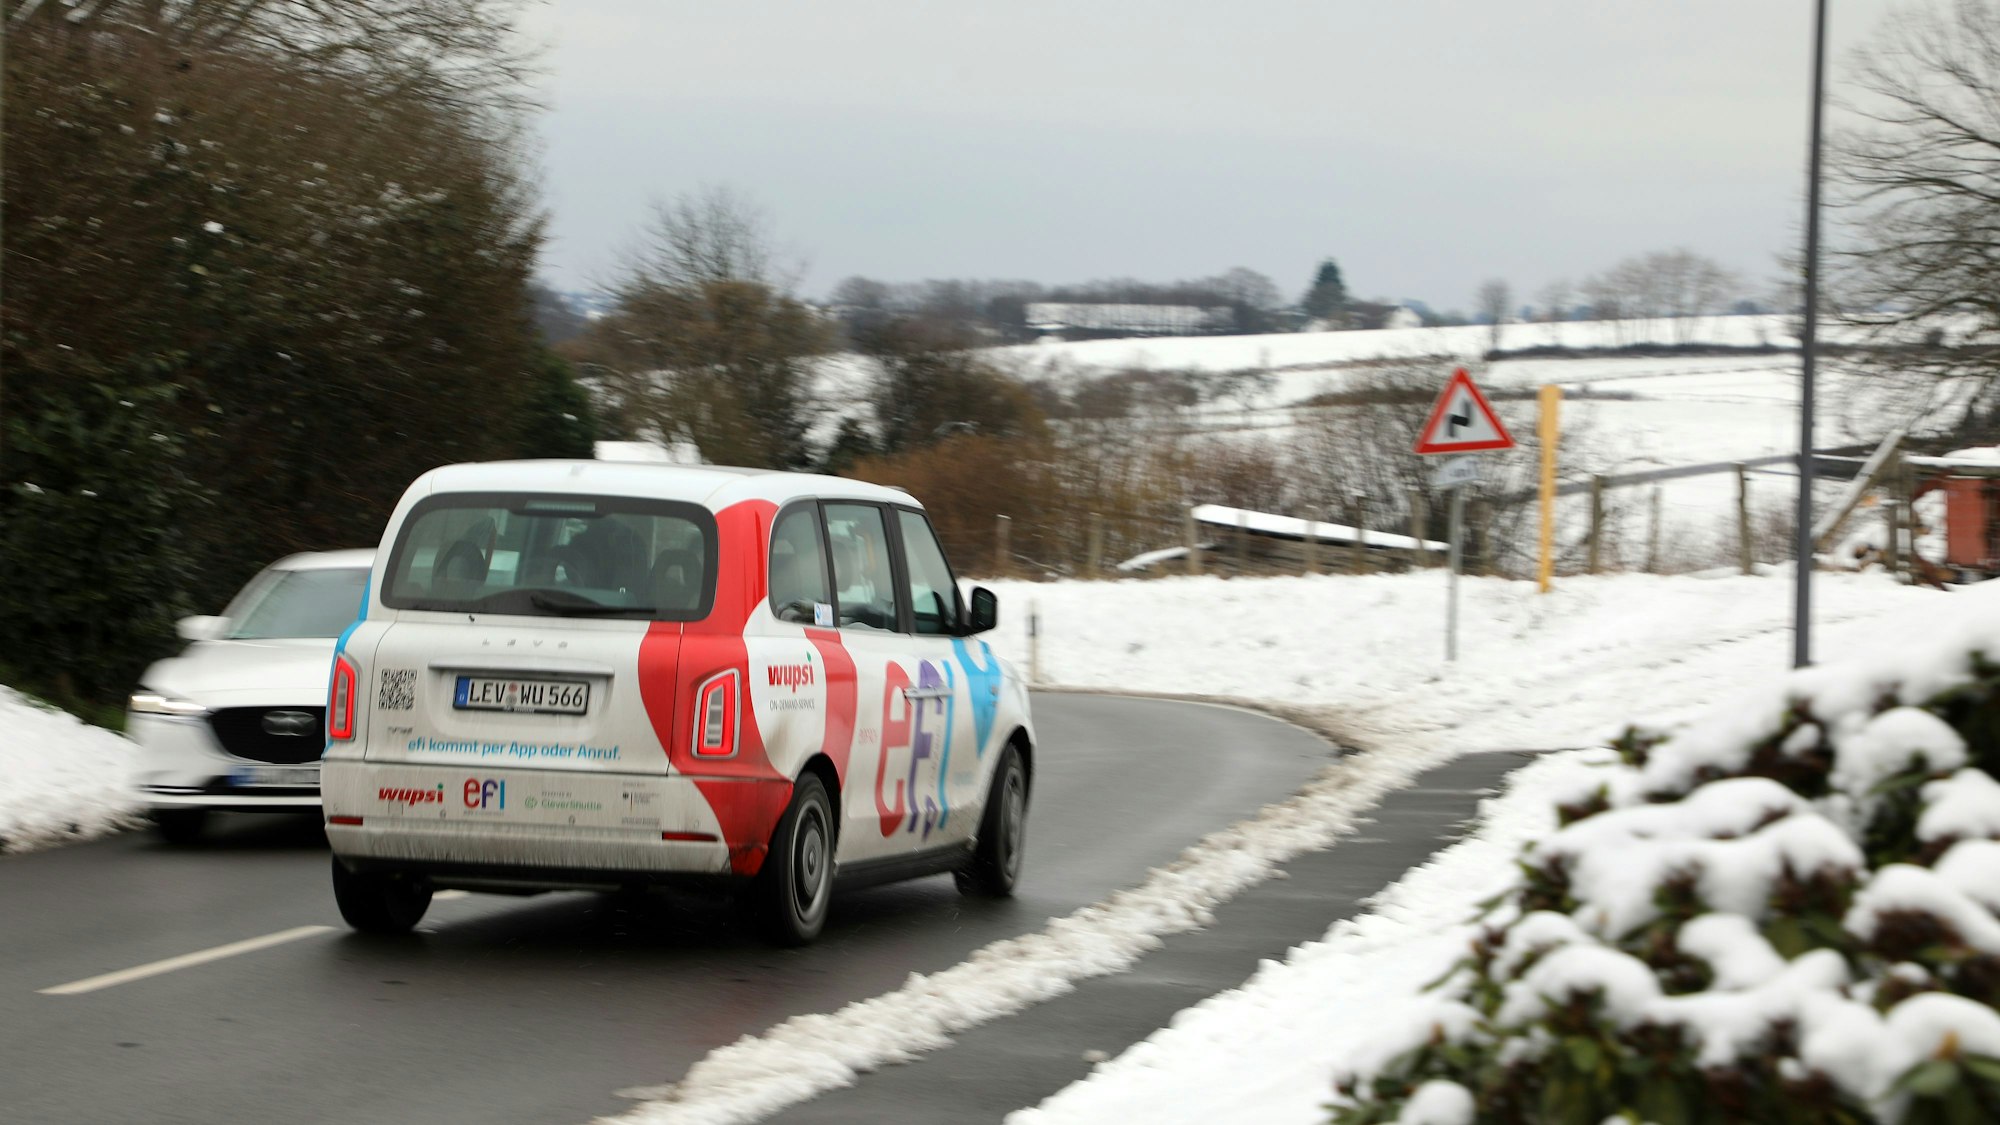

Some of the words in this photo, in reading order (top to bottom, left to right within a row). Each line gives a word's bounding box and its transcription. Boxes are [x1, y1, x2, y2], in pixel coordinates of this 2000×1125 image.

[767, 651, 814, 693] wupsi
[469, 682, 506, 703] LEV
[520, 684, 544, 705] WU
[548, 686, 583, 707] 566
[408, 737, 425, 752] efi
[429, 738, 478, 753] kommt
[482, 743, 506, 757] per
[509, 741, 537, 758] App
[541, 743, 573, 759] oder
[577, 744, 621, 760] Anruf.
[379, 783, 444, 807] wupsi
